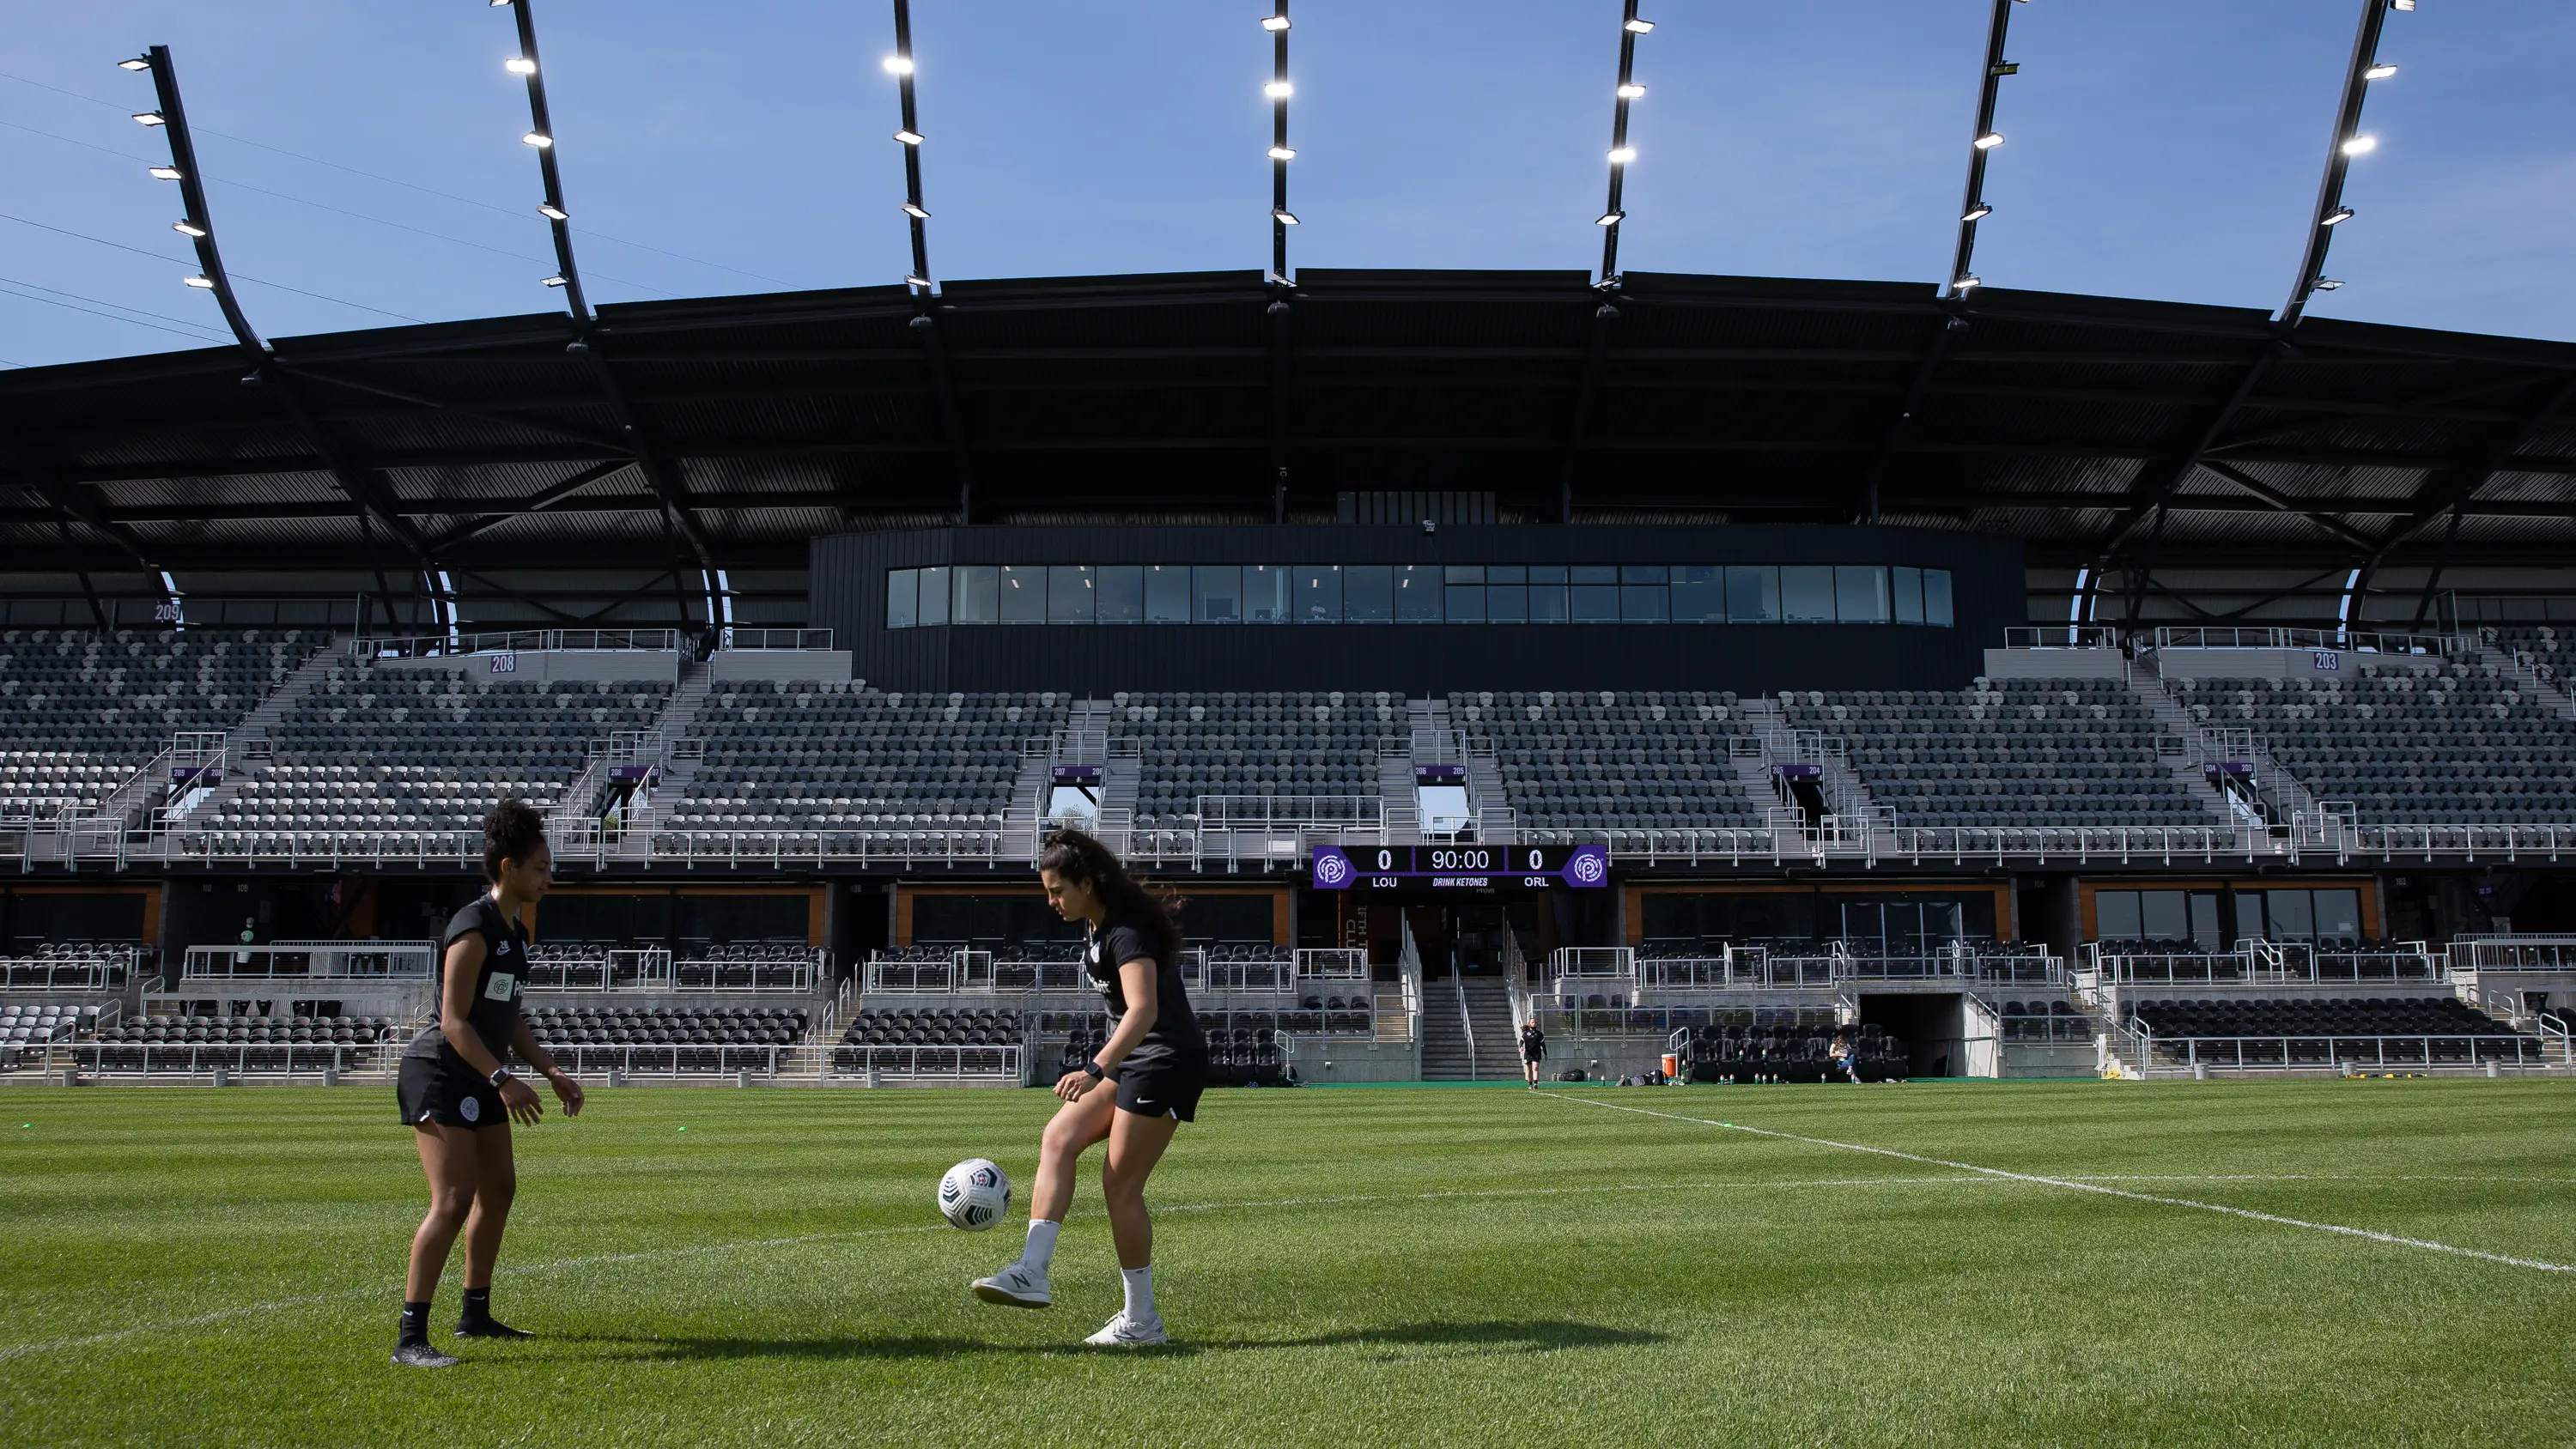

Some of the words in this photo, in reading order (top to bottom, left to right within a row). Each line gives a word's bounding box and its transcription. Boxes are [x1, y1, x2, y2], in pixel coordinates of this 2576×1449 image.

[155, 604, 180, 620] 209
[492, 655, 514, 672] 208
[2316, 652, 2336, 670] 203
[210, 768, 222, 777] 208
[1054, 767, 1065, 776] 207
[1415, 767, 1426, 775] 206
[1453, 767, 1464, 775] 205
[1809, 766, 1820, 774] 204
[2204, 764, 2216, 773] 204
[1378, 850, 1391, 870] 0
[1432, 851, 1489, 869] 90:00
[1529, 850, 1542, 870] 0
[1373, 877, 1397, 888] LOU
[1432, 877, 1455, 887] DRINK
[1455, 877, 1488, 887] KETONES
[1524, 876, 1549, 887] ORL
[238, 883, 248, 893] 109
[1358, 905, 1368, 936] IFTH
